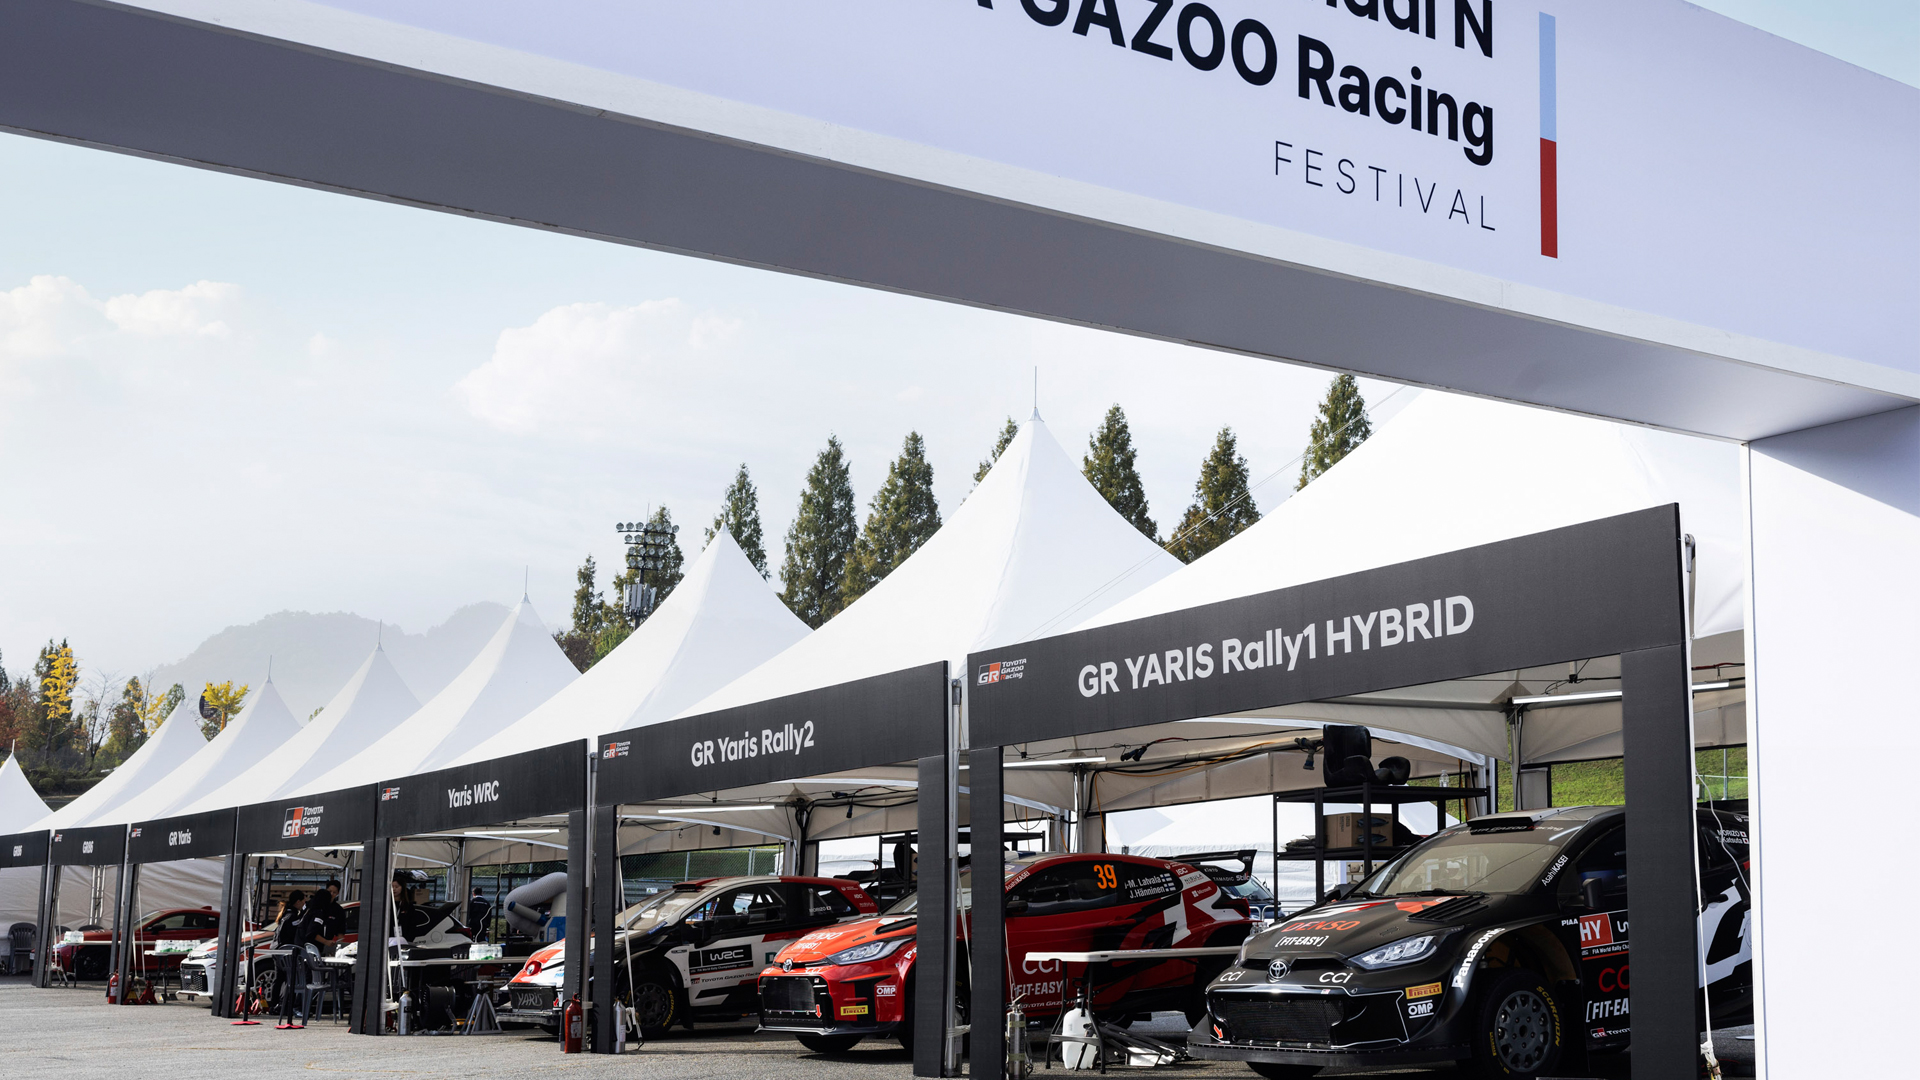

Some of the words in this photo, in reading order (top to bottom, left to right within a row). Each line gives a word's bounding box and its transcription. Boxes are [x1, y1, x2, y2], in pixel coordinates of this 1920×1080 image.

[1454, 0, 1493, 58] N
[1298, 34, 1494, 166] Racing
[1274, 140, 1497, 231] FESTIVAL
[1078, 661, 1120, 697] GR
[1124, 648, 1214, 690] YARIS
[1222, 622, 1317, 675] Rally1
[1326, 595, 1475, 656] HYBRID
[978, 671, 999, 684] GR
[1001, 658, 1027, 668] TOYOTA
[1000, 672, 1023, 680] Racing
[1001, 665, 1025, 674] GAZOO
[691, 742, 715, 767] GR
[717, 731, 758, 763] Yaris
[762, 720, 815, 755] Rally2
[448, 785, 472, 808] Yaris
[473, 780, 500, 804] WRC
[283, 819, 301, 837] GR
[304, 805, 324, 816] TOYOTA
[169, 831, 178, 846] GR
[178, 828, 192, 845] Yaris
[1093, 864, 1118, 890] 39
[1138, 875, 1162, 887] Latvala
[1541, 855, 1569, 887] AsahiKASEI
[1281, 920, 1361, 933] DENSO
[1561, 918, 1579, 926] PIAA
[1580, 919, 1601, 942] HY
[710, 949, 744, 961] WRC
[1451, 927, 1506, 988] Panasonic
[876, 986, 896, 995] OMP
[1408, 984, 1441, 997] PIRELLI
[1408, 1002, 1434, 1016] OMP
[1536, 986, 1561, 1047] SCORPION
